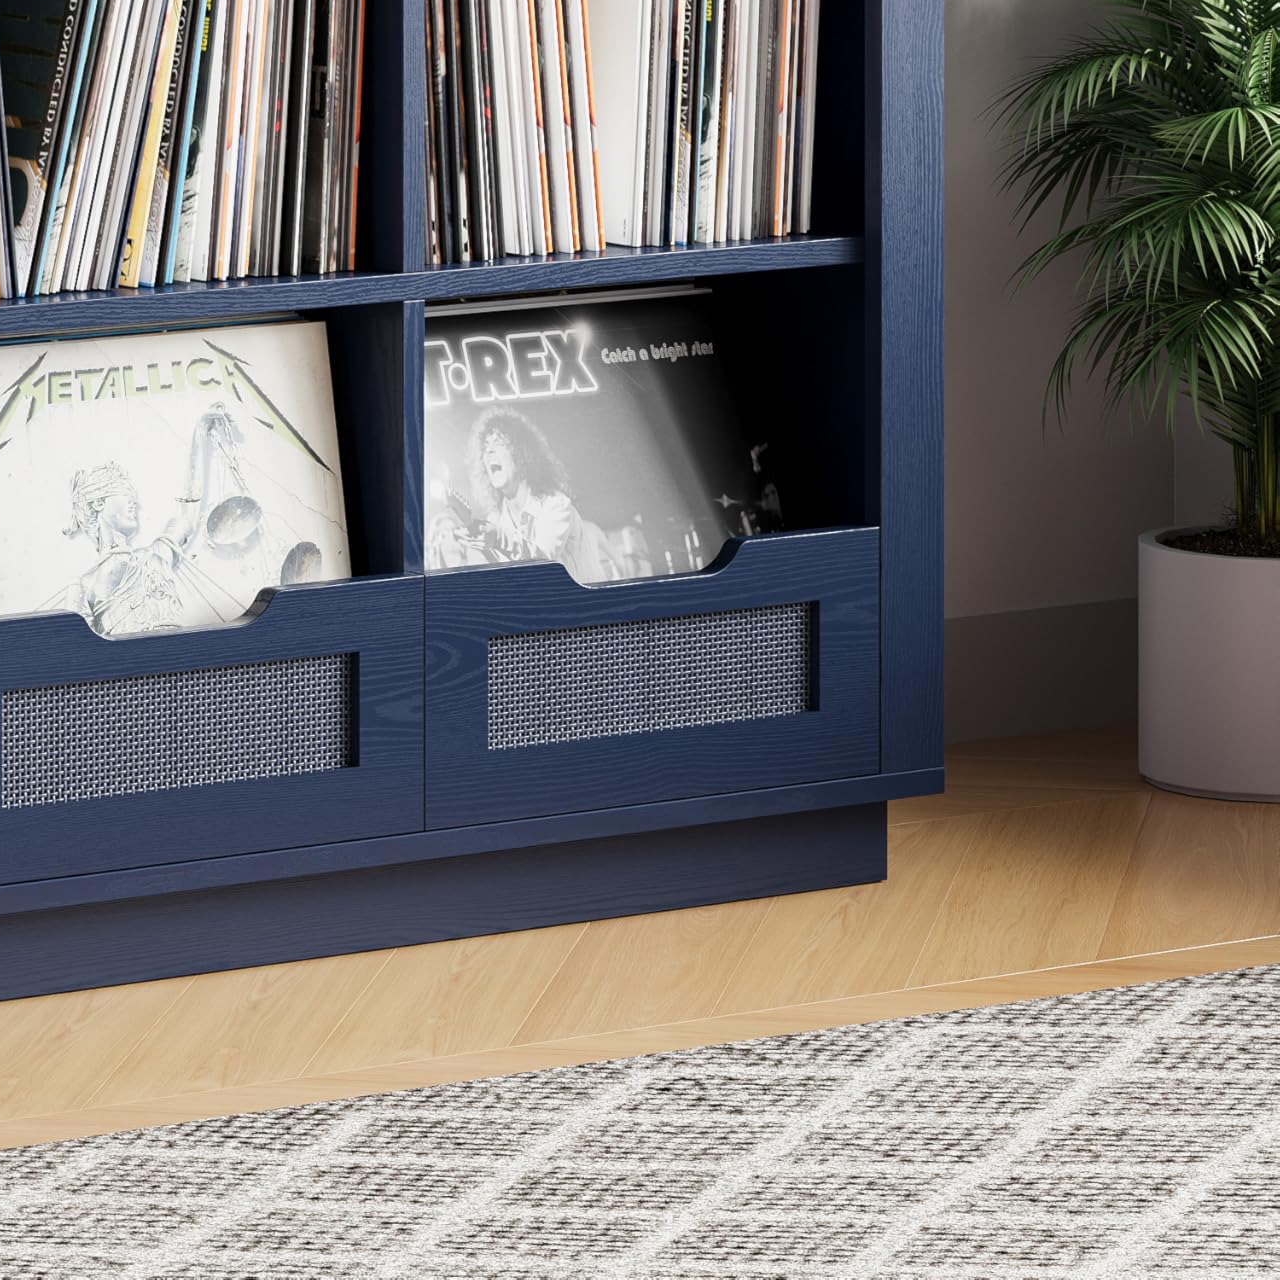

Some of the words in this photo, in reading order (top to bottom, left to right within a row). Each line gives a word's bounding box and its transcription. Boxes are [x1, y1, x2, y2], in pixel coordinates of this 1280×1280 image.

[601, 346, 638, 365] Catch
[640, 347, 649, 361] a
[650, 340, 688, 363] bright
[691, 338, 714, 357] star
